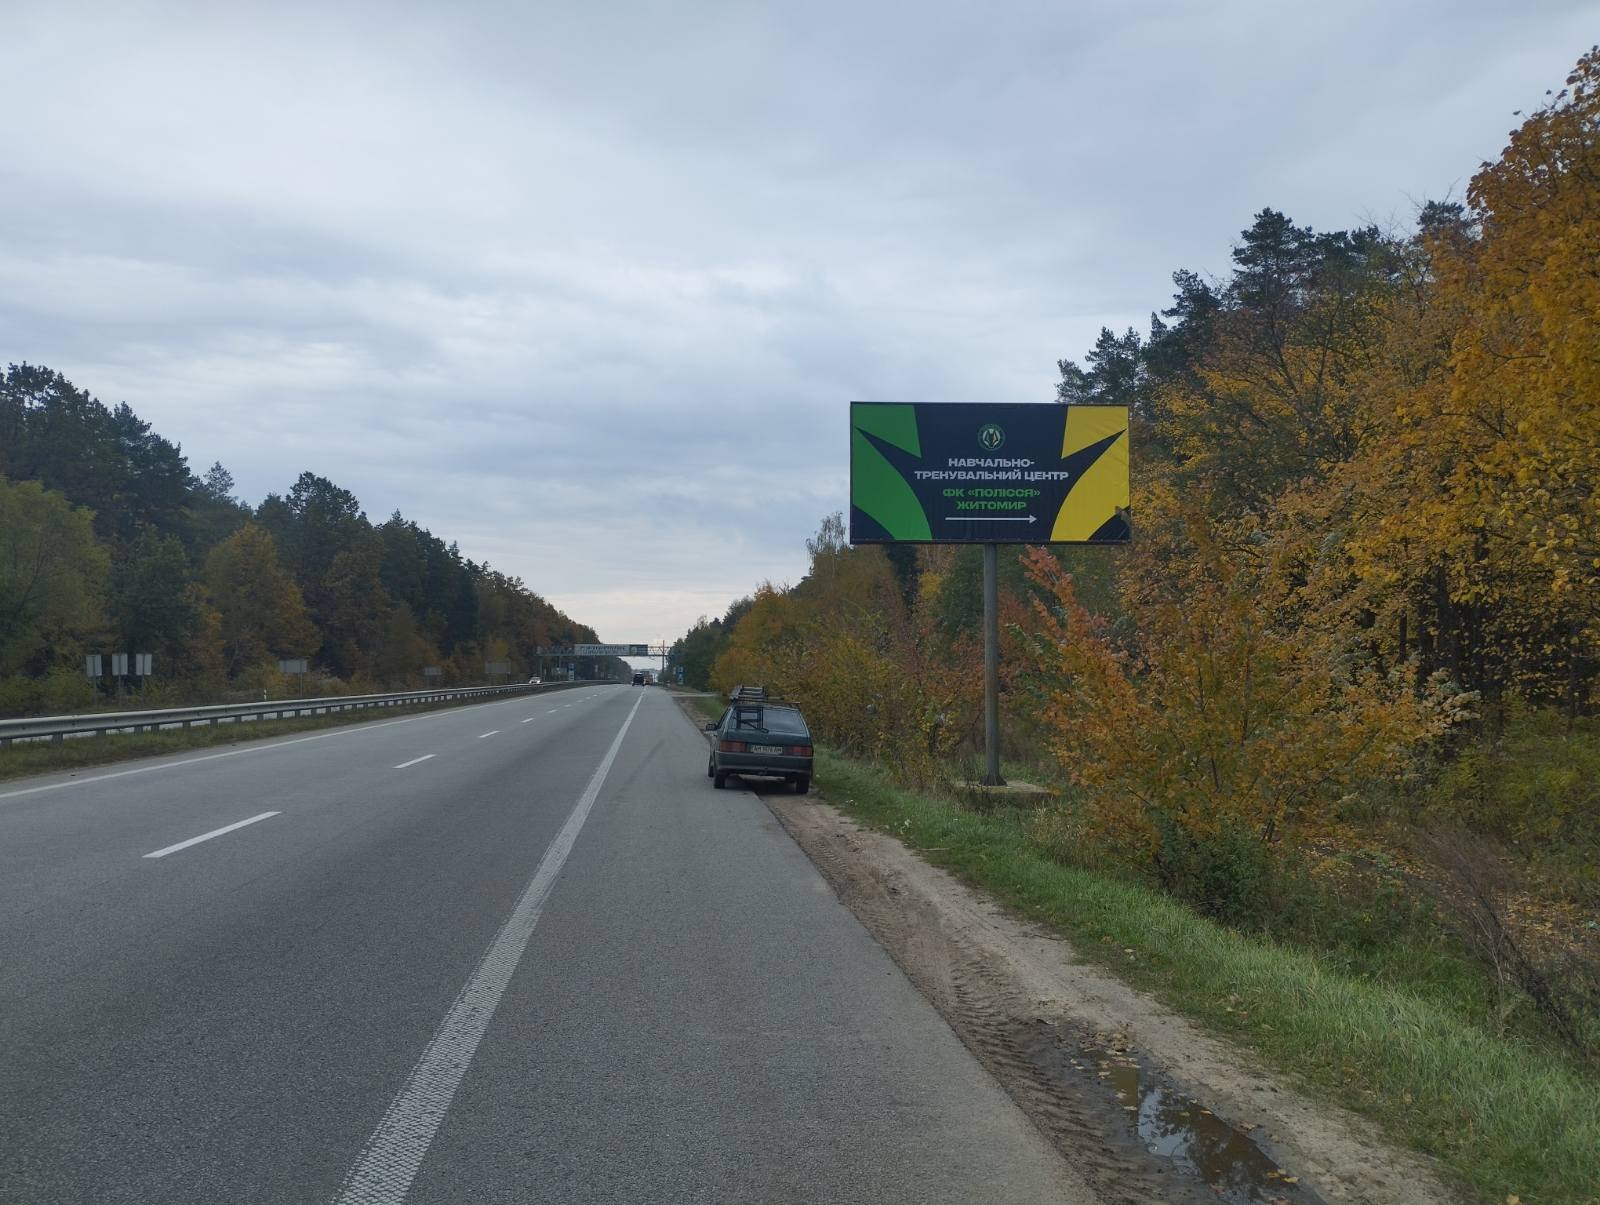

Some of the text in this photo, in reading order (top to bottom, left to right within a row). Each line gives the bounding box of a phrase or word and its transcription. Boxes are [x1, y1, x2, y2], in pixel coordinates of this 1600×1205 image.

[948, 458, 1035, 468] НАВЧАЛЬНО-
[914, 469, 1069, 481] ТРЕНУВАЛЬНИЙ ЦЕНТР
[943, 488, 1041, 497] ФК «ПОЛІССЯ»
[957, 501, 1027, 510] ЖИТОМИР
